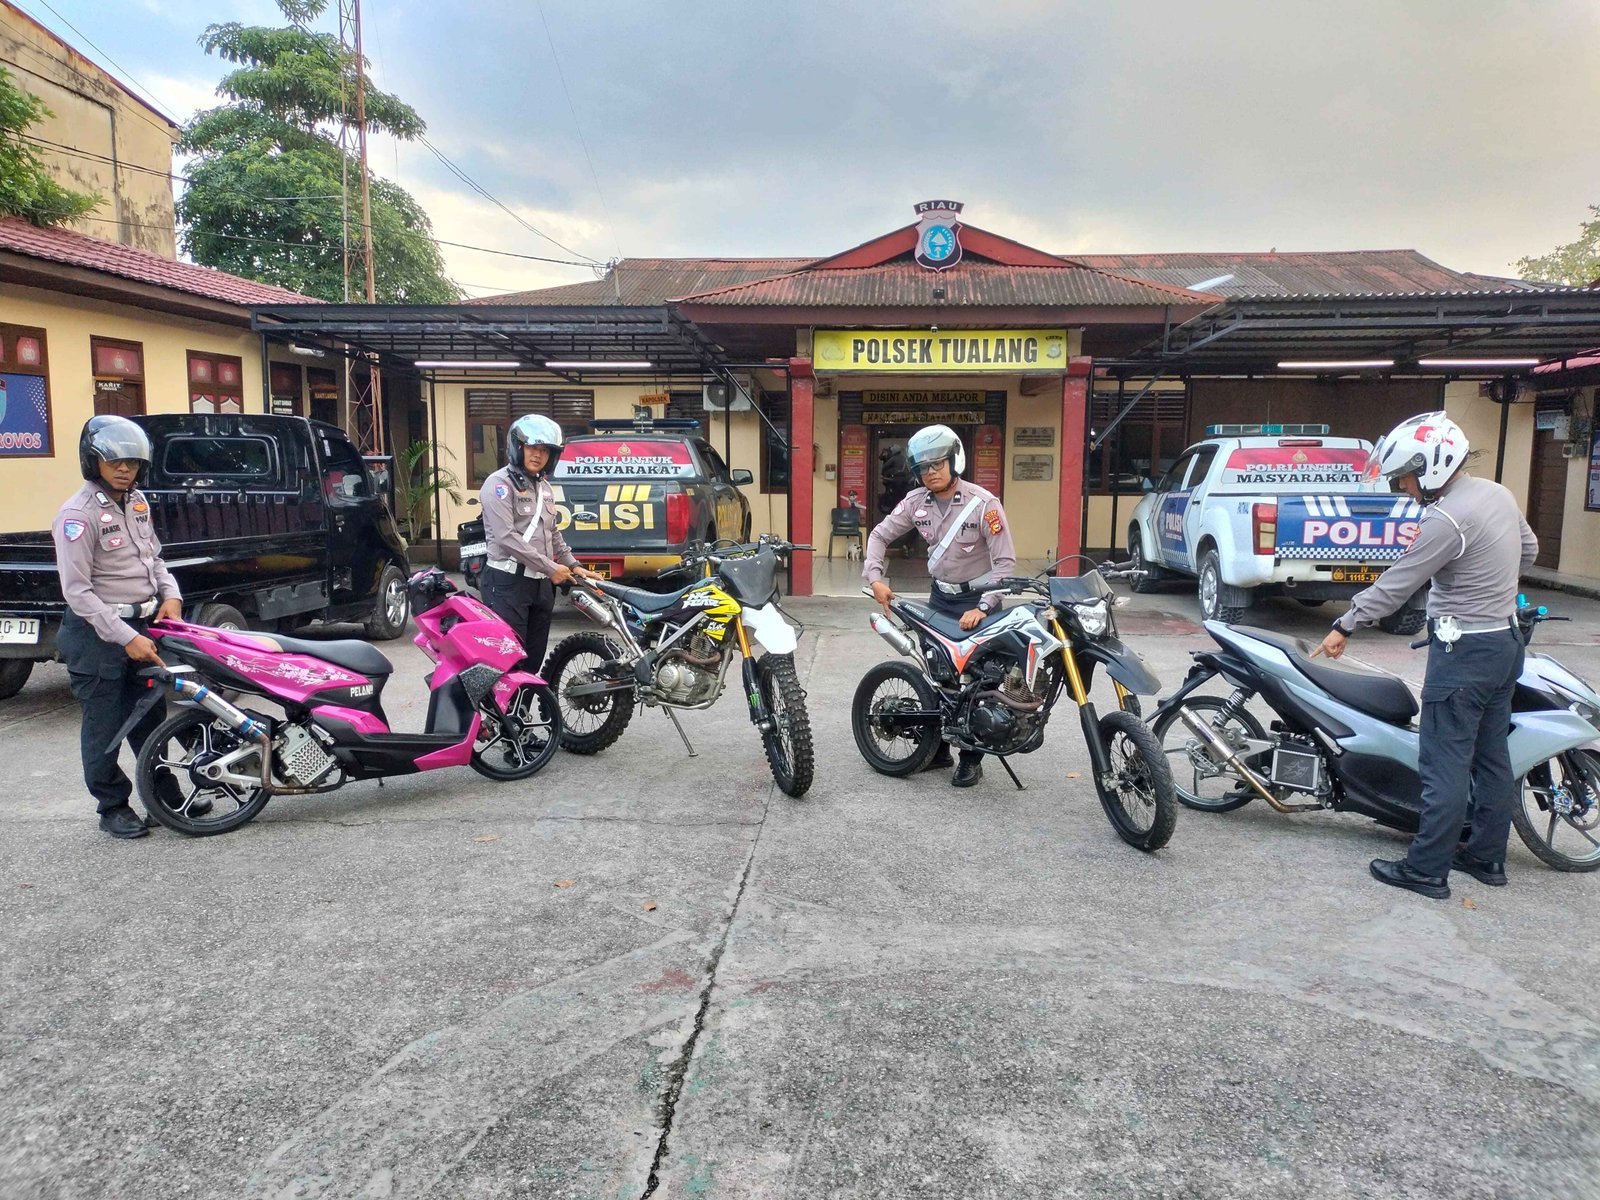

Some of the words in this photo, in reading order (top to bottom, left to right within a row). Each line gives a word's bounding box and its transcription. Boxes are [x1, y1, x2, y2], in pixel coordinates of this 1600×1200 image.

[920, 201, 957, 212] RIAU
[852, 338, 932, 363] POLSEK
[939, 338, 1038, 363] TUALANG
[870, 392, 899, 402] DISINI
[901, 392, 927, 402] ANDA
[932, 392, 978, 402] MELAPOR
[575, 456, 620, 464] POLRI
[621, 456, 673, 465] UNTUK
[567, 466, 681, 475] MASYARAKAT
[1245, 463, 1297, 472] POLRI
[1299, 463, 1354, 472] UNTUK
[1236, 473, 1363, 483] MASYARAKAT
[554, 503, 654, 531] OLISI
[576, 512, 592, 521] Ford
[1302, 520, 1421, 546] POLIS
[904, 603, 925, 618] HONDA
[19, 621, 35, 634] DI
